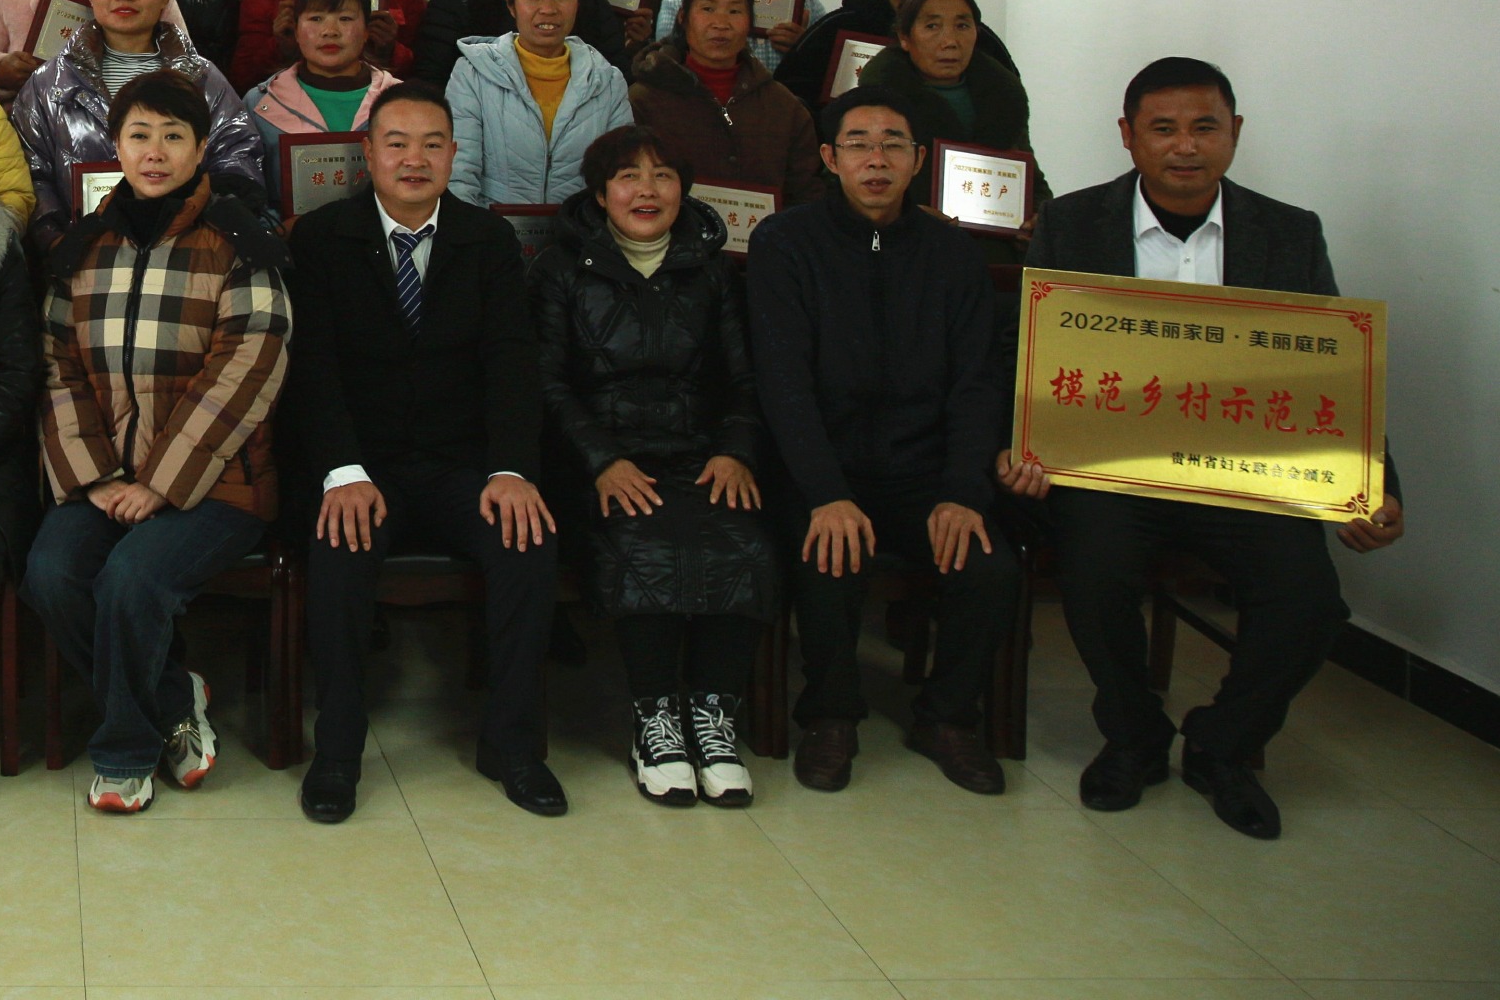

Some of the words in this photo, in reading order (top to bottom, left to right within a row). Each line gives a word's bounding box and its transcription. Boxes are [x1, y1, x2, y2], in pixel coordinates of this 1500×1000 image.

[961, 180, 1008, 200] 模范户
[1050, 367, 1345, 437] 模范乡村示范点
[1172, 452, 1336, 485] 贵州省妇女联合会颁发
